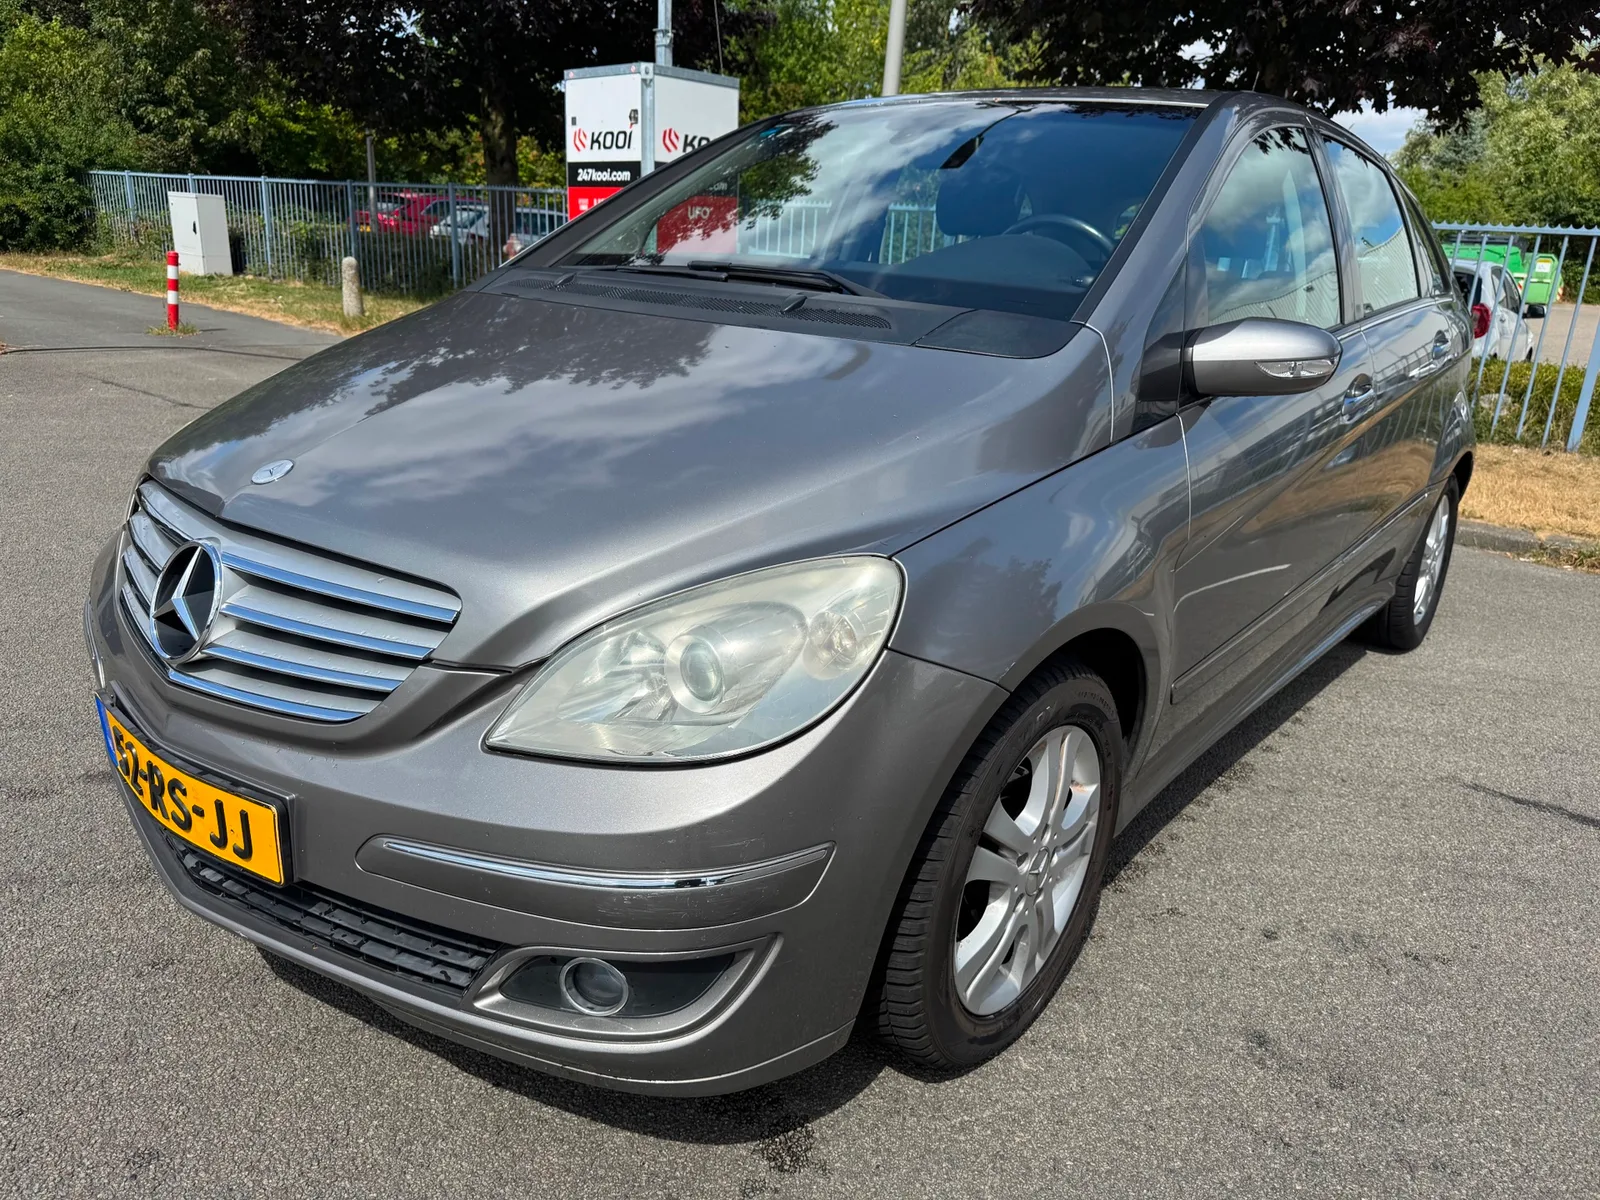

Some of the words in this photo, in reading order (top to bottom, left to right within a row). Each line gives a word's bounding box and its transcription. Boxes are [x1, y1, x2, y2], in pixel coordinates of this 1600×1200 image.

[577, 168, 631, 182] 247kooi.com
[687, 205, 710, 219] UFO
[112, 725, 253, 861] 52-RS-JJ
